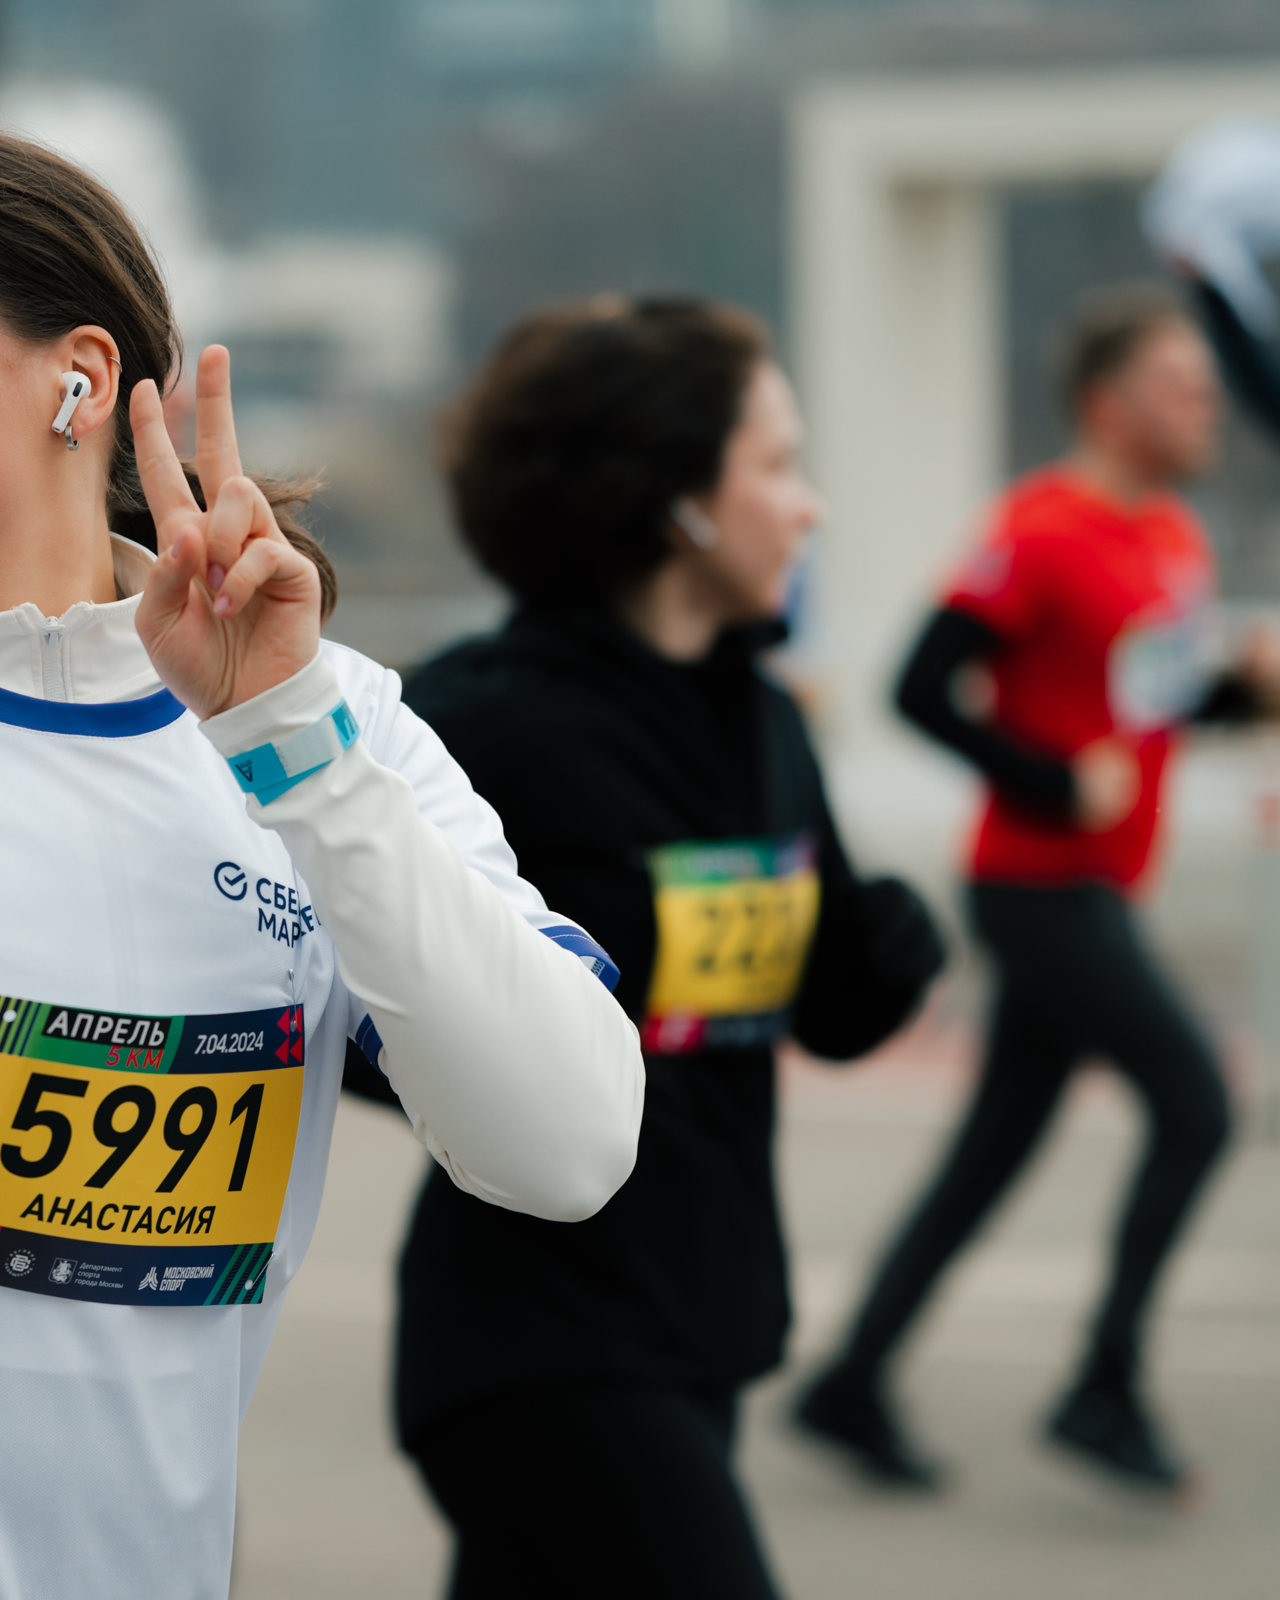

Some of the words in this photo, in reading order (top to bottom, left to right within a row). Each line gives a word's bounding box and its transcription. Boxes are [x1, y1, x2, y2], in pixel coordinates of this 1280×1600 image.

[256, 877, 301, 916] СБЕ
[45, 1009, 166, 1048] АПРЕЛЬ
[193, 1030, 265, 1056] 7.04.2024
[105, 1045, 121, 1067] 5
[0, 1072, 266, 1194] 5991
[20, 1193, 216, 1235] АНАСТАСИЯ
[77, 1270, 101, 1279] спорта
[79, 1262, 124, 1273] Департамент
[163, 1263, 215, 1279] МОСКОВСКИЙ
[74, 1278, 98, 1287] города
[98, 1280, 124, 1289] Москвы
[159, 1279, 186, 1291] СПОРТ
